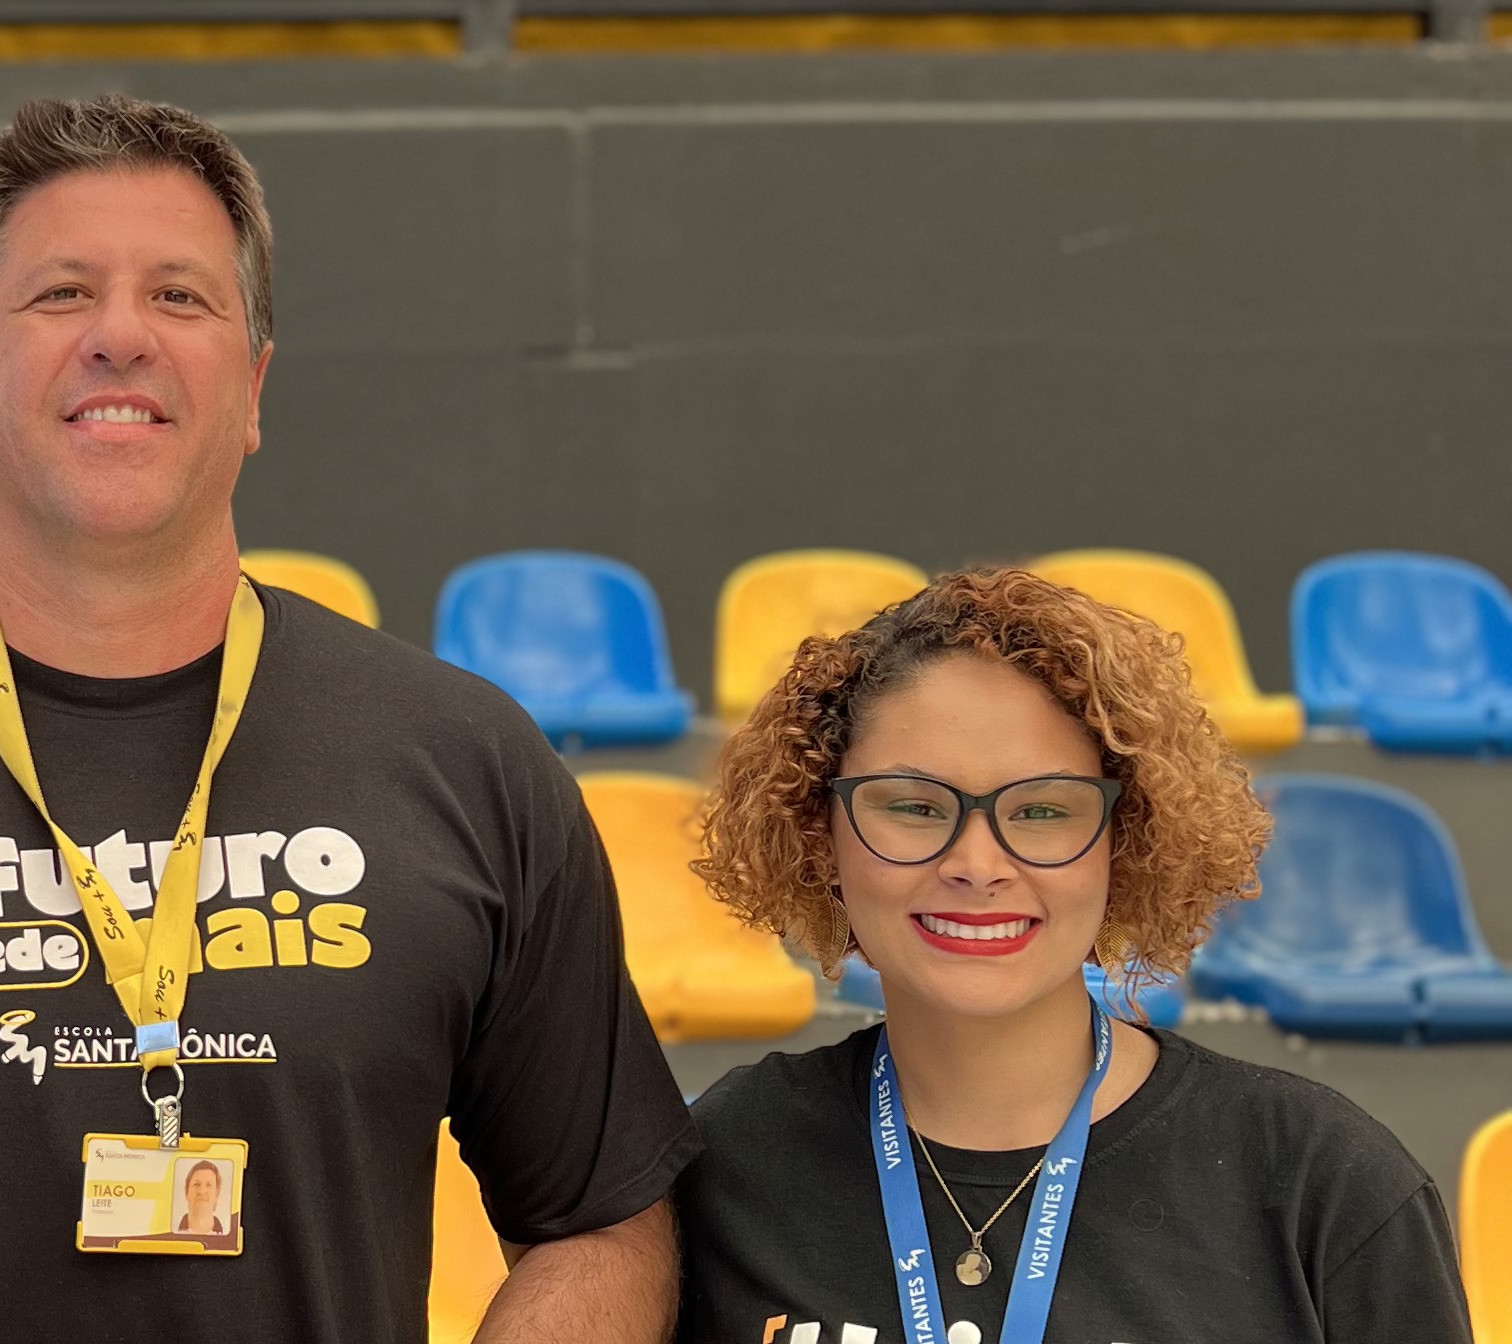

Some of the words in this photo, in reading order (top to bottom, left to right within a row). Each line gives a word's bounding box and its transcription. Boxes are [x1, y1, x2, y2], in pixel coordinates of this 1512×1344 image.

[106, 889, 372, 985] ais
[54, 1026, 113, 1037] ESCOLA
[176, 1028, 277, 1058] ÔNICA
[878, 1079, 902, 1170] VISITANTES
[93, 1184, 136, 1197] TIAGO
[1027, 1183, 1065, 1280] VISITANTES
